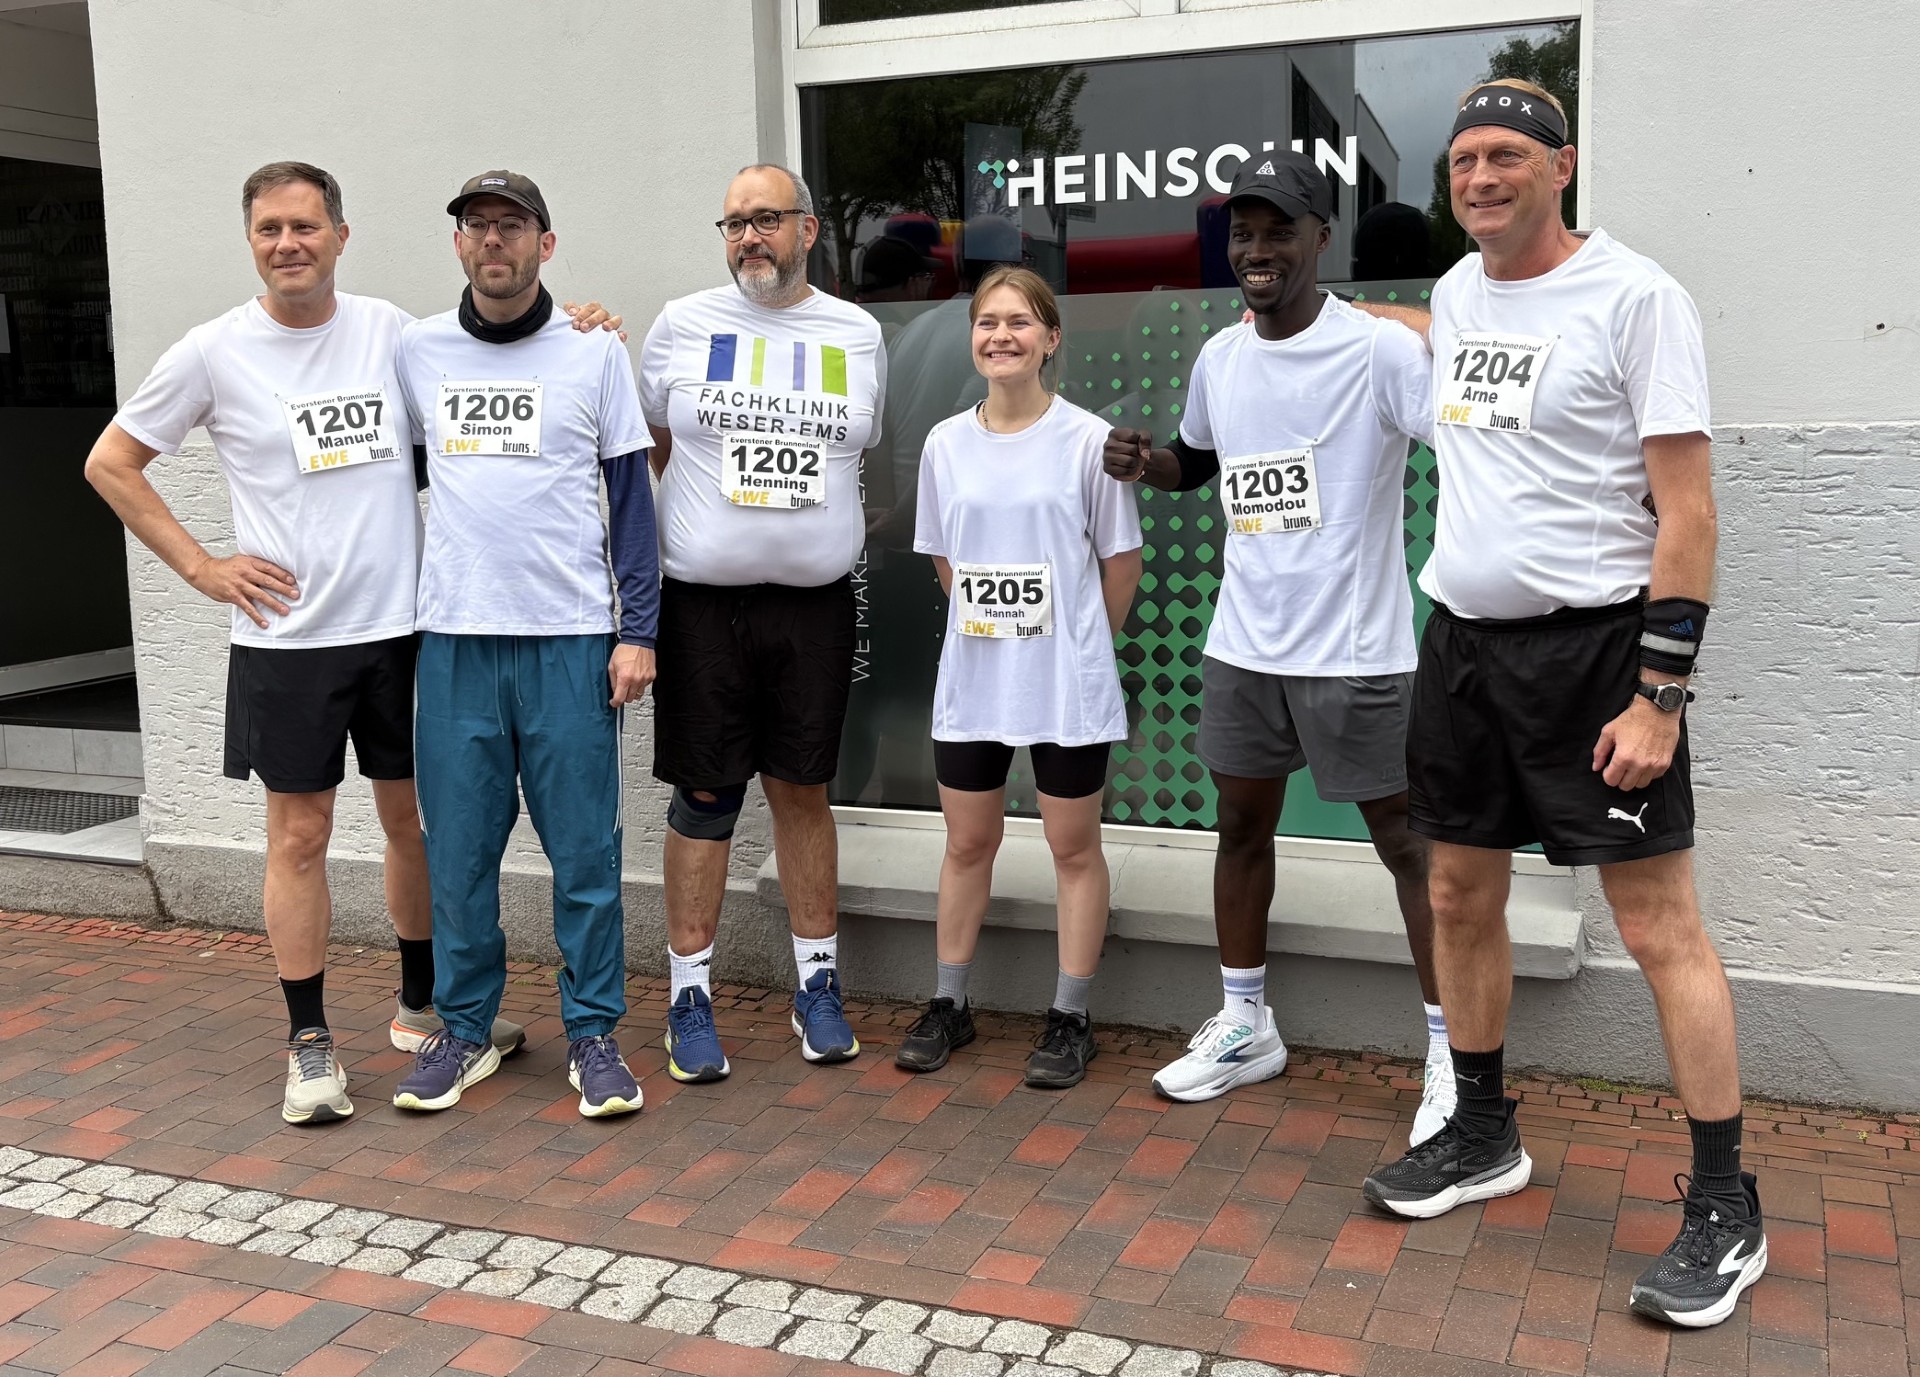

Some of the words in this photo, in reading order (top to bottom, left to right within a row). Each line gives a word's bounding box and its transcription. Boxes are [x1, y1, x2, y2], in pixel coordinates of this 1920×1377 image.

[1008, 135, 1358, 207] HEINSON
[1454, 349, 1534, 388] 1204
[444, 394, 534, 421] 1206
[699, 388, 849, 420] FACHKLINIK
[1461, 386, 1498, 403] Arne
[296, 400, 384, 436] 1207
[460, 423, 512, 436] Simon
[697, 409, 848, 441] WESER-EMS
[1441, 404, 1472, 422] EWE
[1490, 410, 1519, 430] bruns
[317, 429, 380, 450] Manuel
[445, 439, 481, 452] EWE
[502, 440, 529, 453] bruns
[310, 449, 349, 469] EWE
[369, 446, 394, 460] bruns
[731, 445, 819, 477] 1202
[740, 474, 808, 493] Henning
[1226, 464, 1309, 500] 1203
[1231, 498, 1306, 516] Momodou
[1234, 517, 1263, 532] EWE
[1283, 515, 1312, 530] bruns
[960, 577, 1044, 605] 1205
[984, 608, 1025, 618] Hannah
[964, 620, 995, 636] EWE
[1016, 623, 1043, 636] bruns
[851, 639, 870, 683] WE
